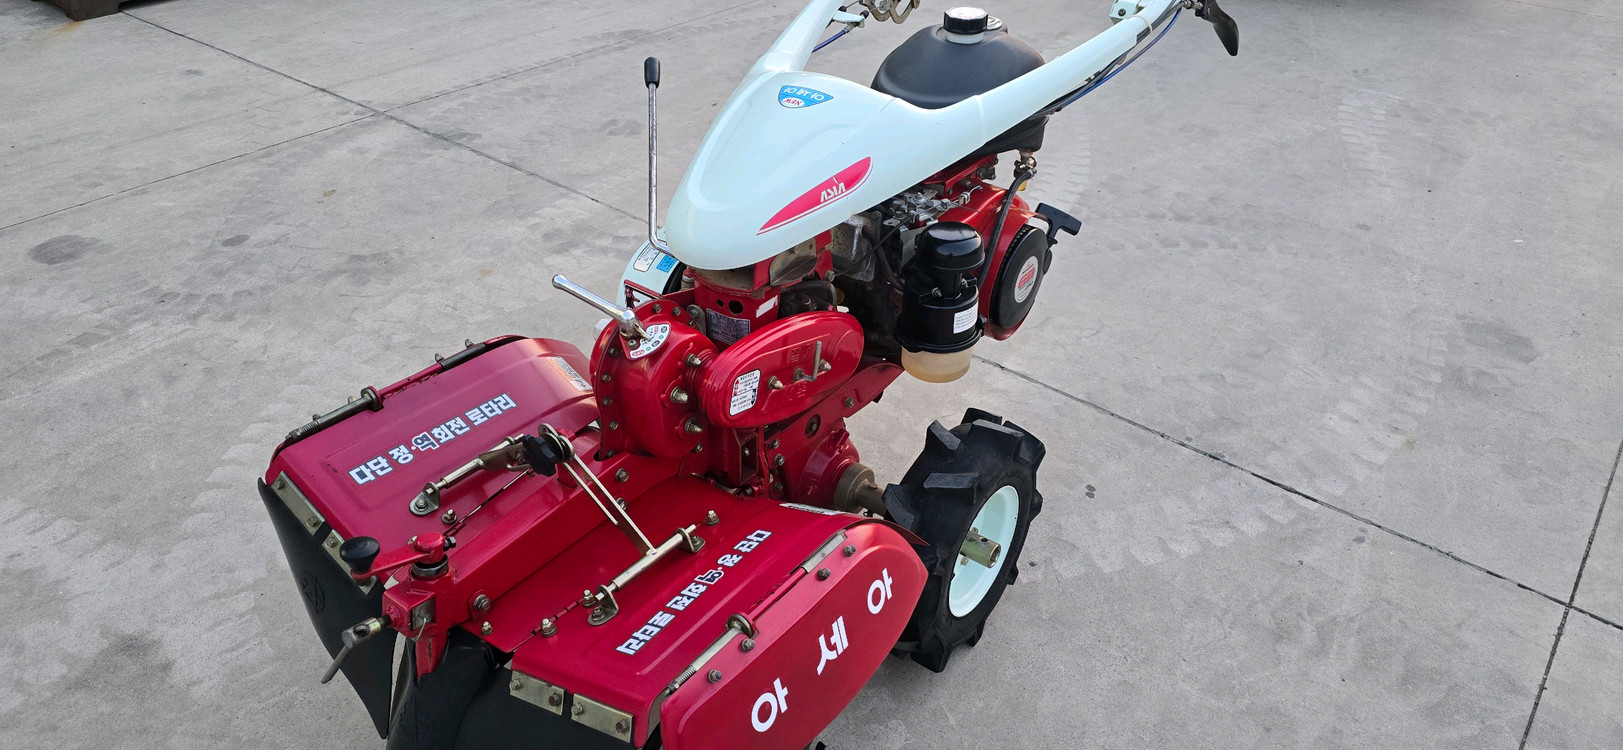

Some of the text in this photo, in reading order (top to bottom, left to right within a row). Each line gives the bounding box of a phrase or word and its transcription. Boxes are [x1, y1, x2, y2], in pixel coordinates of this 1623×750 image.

[783, 98, 803, 106] NEW
[820, 178, 846, 203] ASIA
[348, 455, 394, 485] 다단
[464, 392, 518, 427] 로타리
[733, 529, 773, 553] 다단
[615, 610, 676, 656] 로타리
